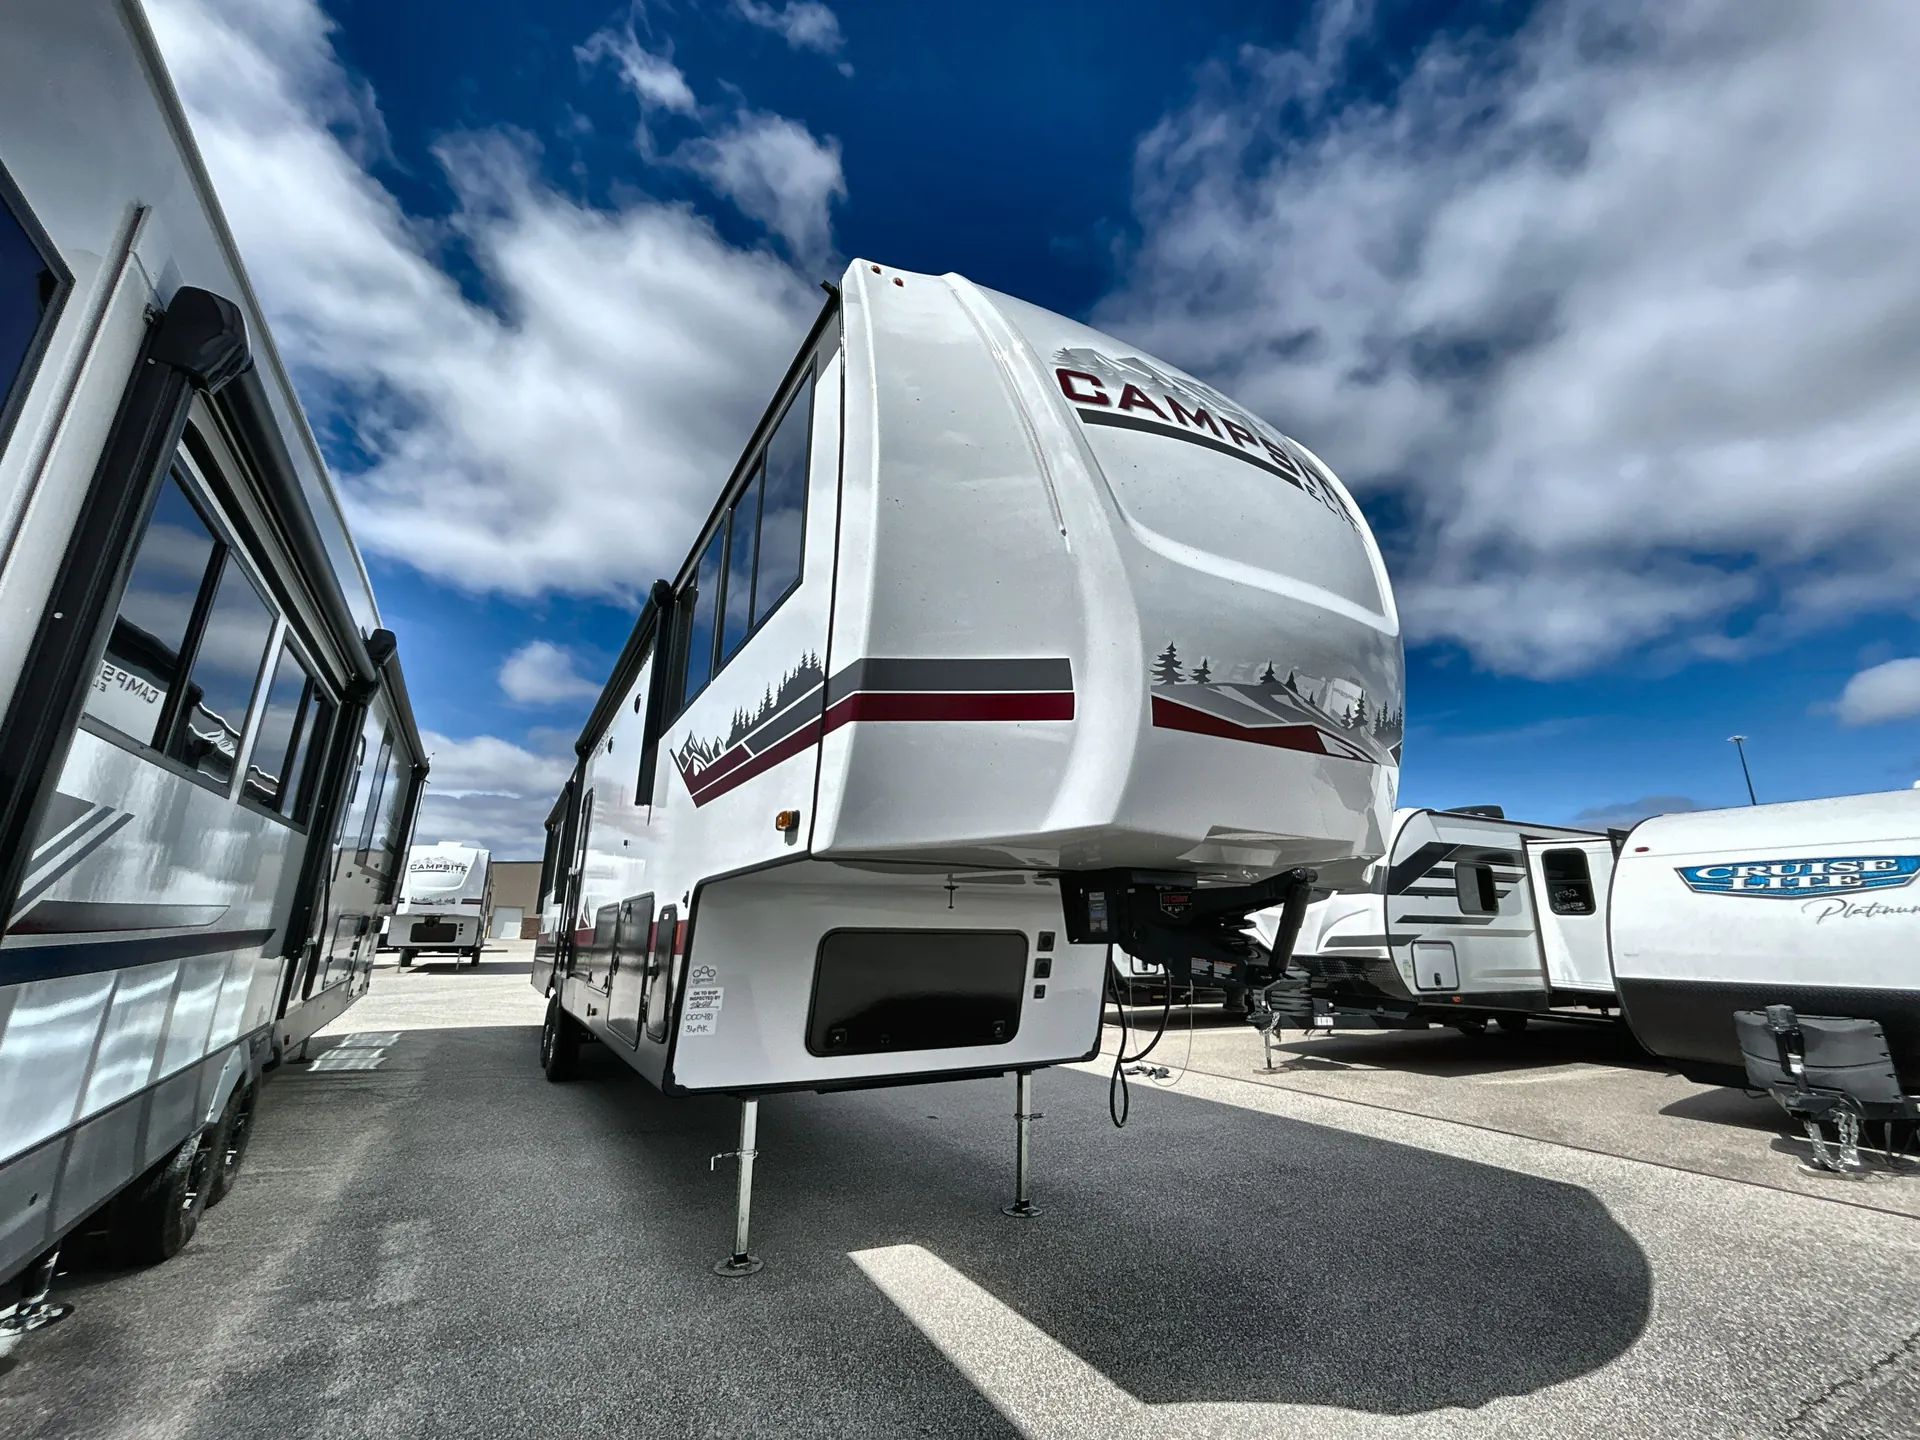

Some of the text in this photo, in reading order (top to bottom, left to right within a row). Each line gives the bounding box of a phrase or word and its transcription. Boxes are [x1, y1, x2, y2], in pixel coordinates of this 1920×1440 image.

[1303, 483, 1363, 538] ELIT
[410, 863, 468, 873] CAMPSITE
[1695, 858, 1898, 878] CRUISE
[1728, 873, 1863, 890] LITE
